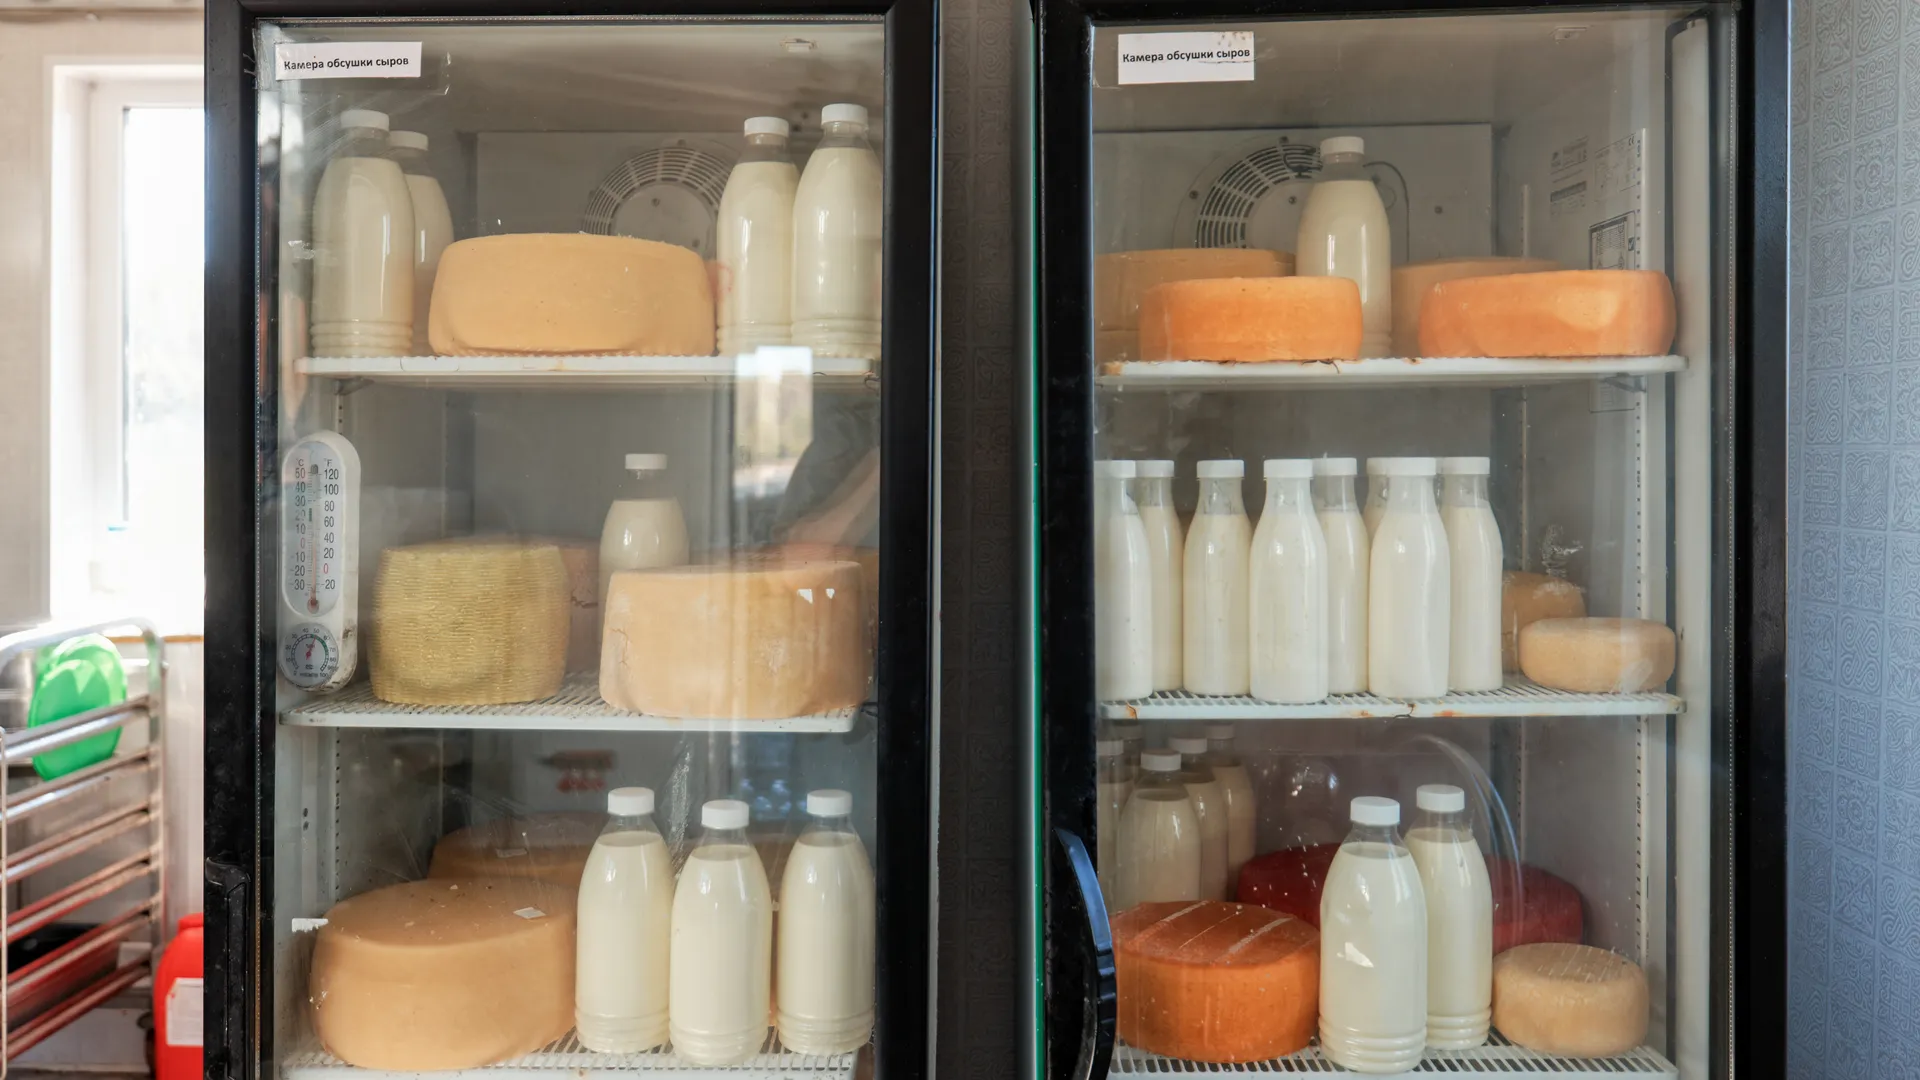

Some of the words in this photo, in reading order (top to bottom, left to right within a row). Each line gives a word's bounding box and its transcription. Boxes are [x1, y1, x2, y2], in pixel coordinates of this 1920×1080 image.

[1122, 53, 1164, 63] Камера
[1166, 50, 1213, 62] обсушки
[1216, 49, 1250, 60] сыров
[284, 60, 324, 70] Камера
[327, 58, 373, 69] обсушки
[375, 57, 409, 68] сыров
[295, 467, 306, 479] 50
[324, 468, 339, 480] 120
[295, 481, 306, 493] 40
[324, 483, 339, 495] 100
[295, 495, 306, 507] 30
[324, 500, 335, 512] 80
[324, 516, 335, 528] 60
[295, 523, 306, 535] 10
[300, 537, 306, 549] 0
[323, 532, 335, 543] 40
[323, 547, 335, 559] 20
[323, 562, 329, 574] 0
